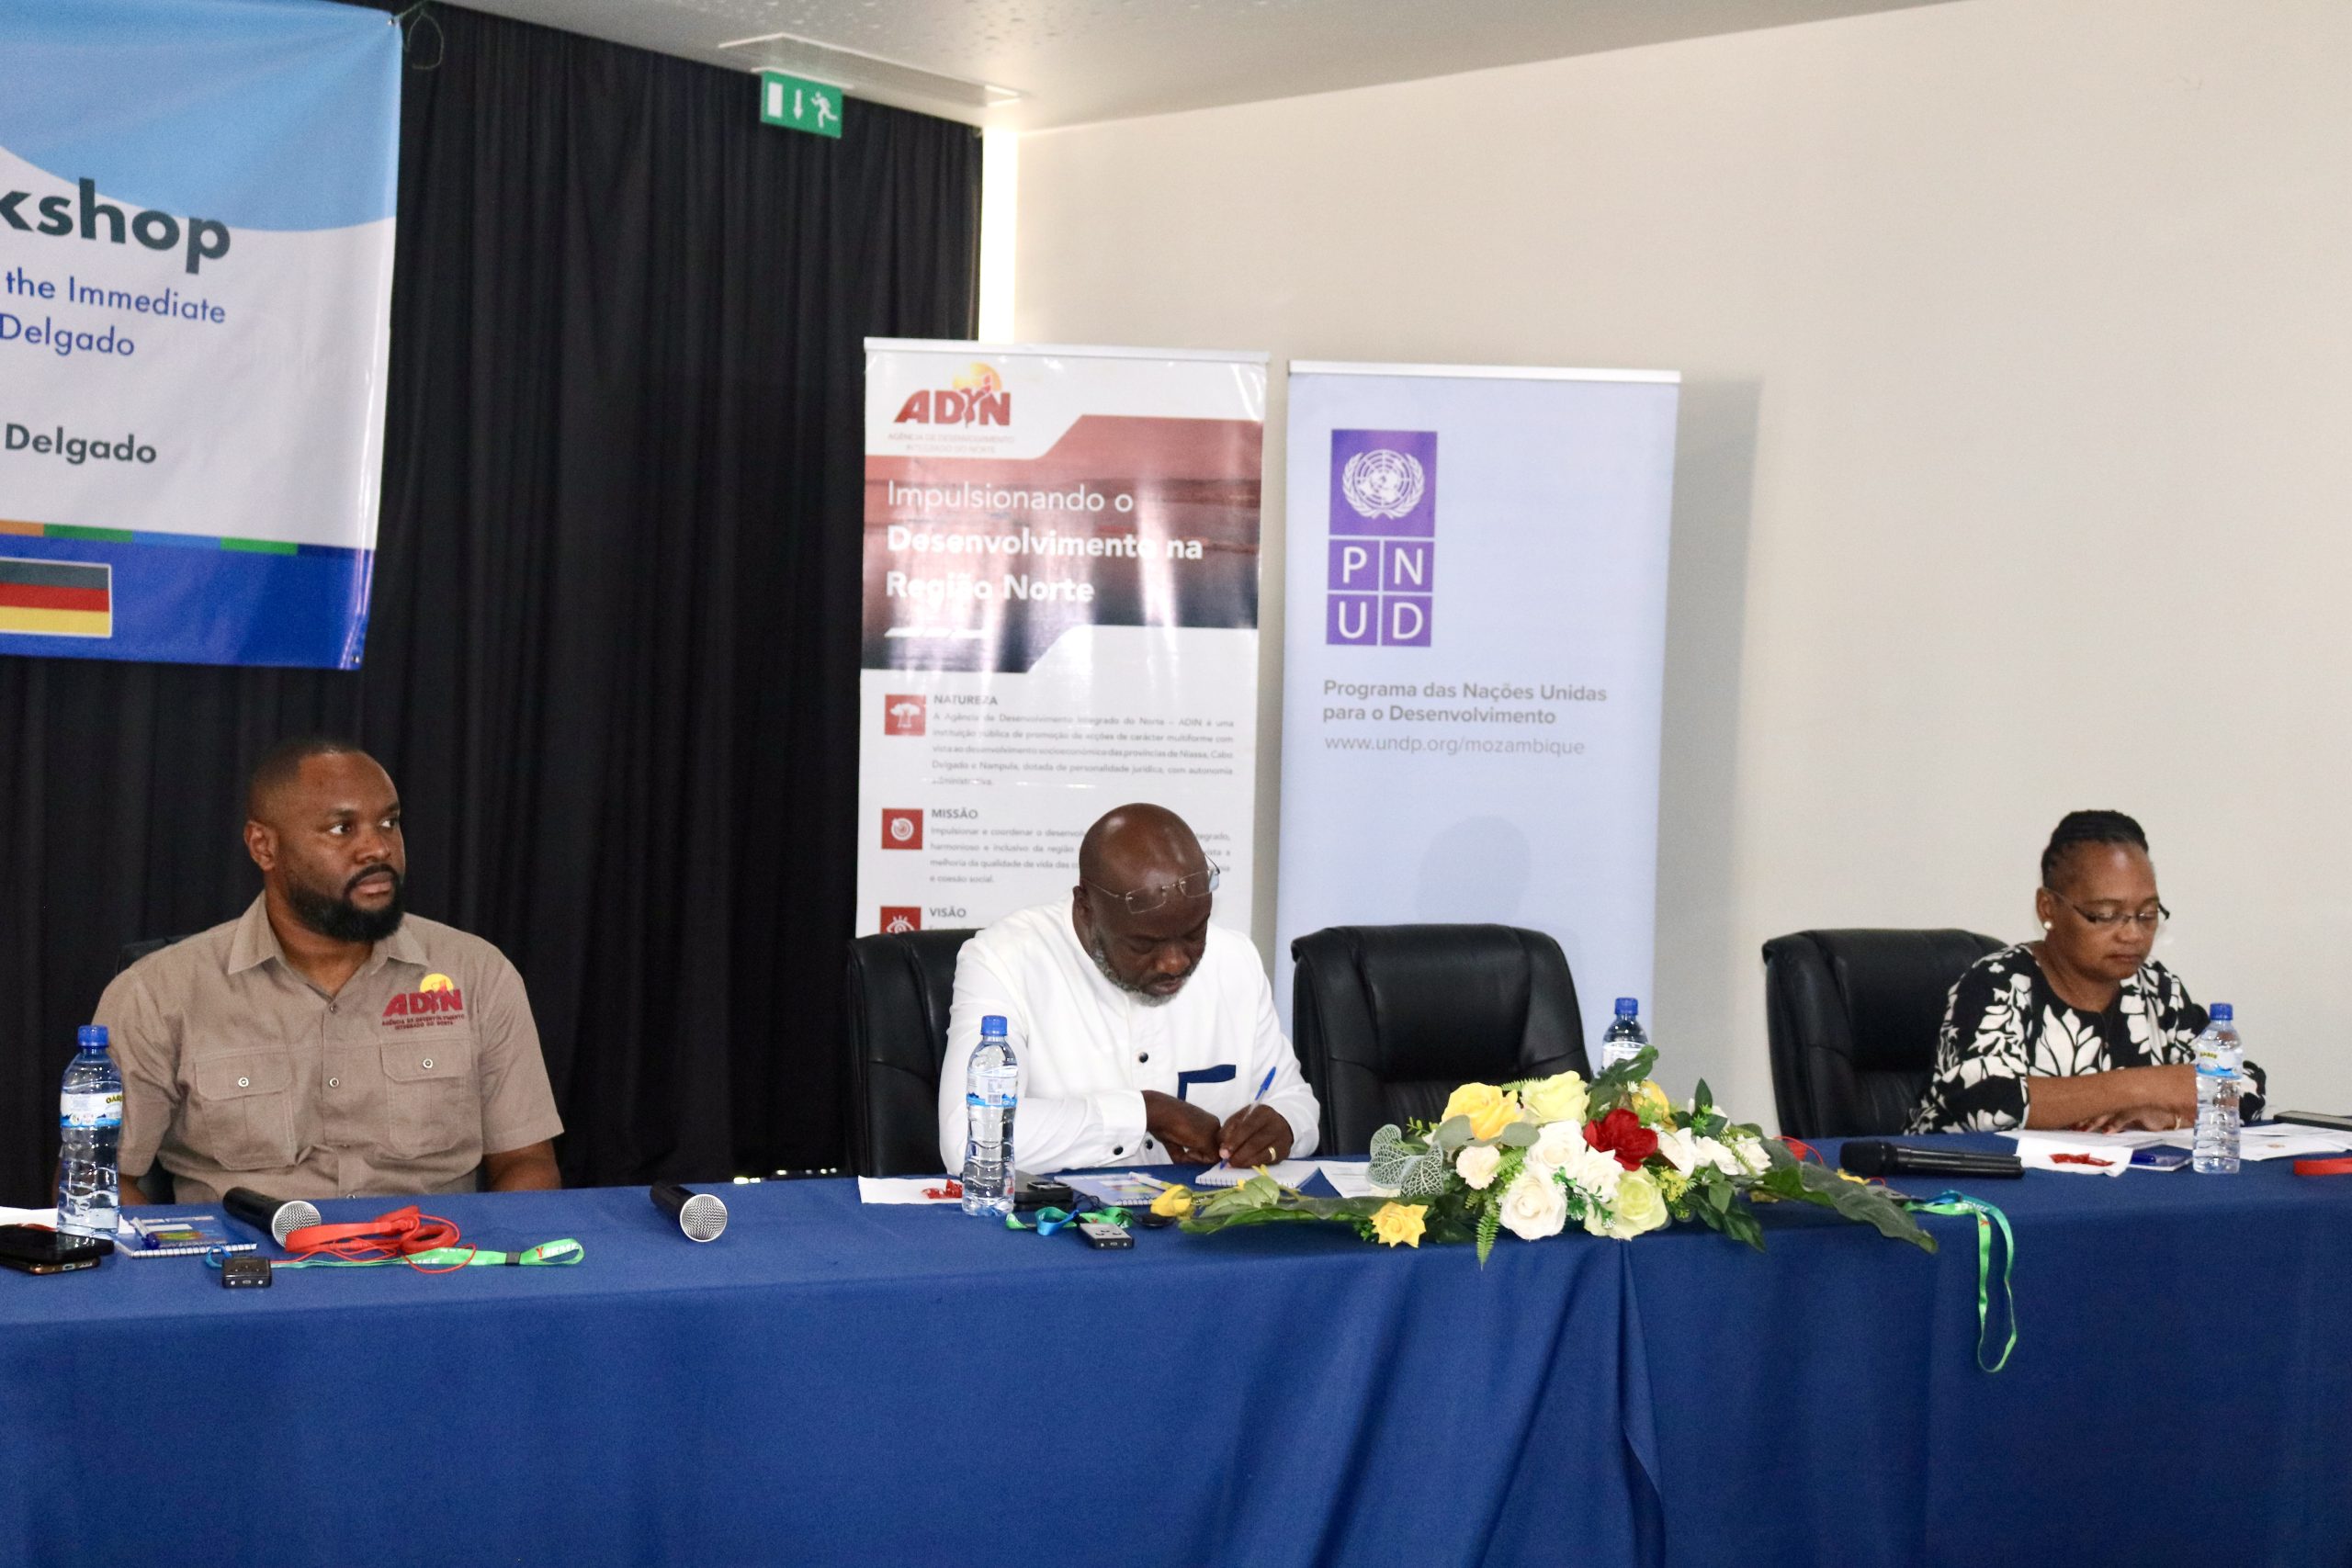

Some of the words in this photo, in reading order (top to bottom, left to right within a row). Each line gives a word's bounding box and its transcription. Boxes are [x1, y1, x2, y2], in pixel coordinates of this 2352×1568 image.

[6, 266, 55, 299] the
[69, 276, 225, 323] Immediate
[0, 313, 134, 356] Delgado
[5, 423, 157, 464] Delgado
[888, 480, 1104, 513] Impulsionando
[1114, 493, 1133, 513] o
[888, 525, 1157, 558] Desenvolvimento
[1166, 536, 1204, 560] na
[887, 570, 993, 606] Região
[1004, 574, 1094, 604] Norte
[933, 694, 998, 705] NATUREZA
[1324, 680, 1417, 701] Programa
[1424, 682, 1456, 699] das
[1463, 682, 1533, 704] Nações
[1540, 684, 1607, 703] Unidas
[1323, 706, 1365, 724] para
[1372, 709, 1384, 722] o
[1389, 705, 1556, 726] Desenvolvimento
[1324, 735, 1585, 758] www.undp.org/mozambique
[931, 807, 978, 819] MISSÃO
[930, 905, 966, 918] VISÃO
